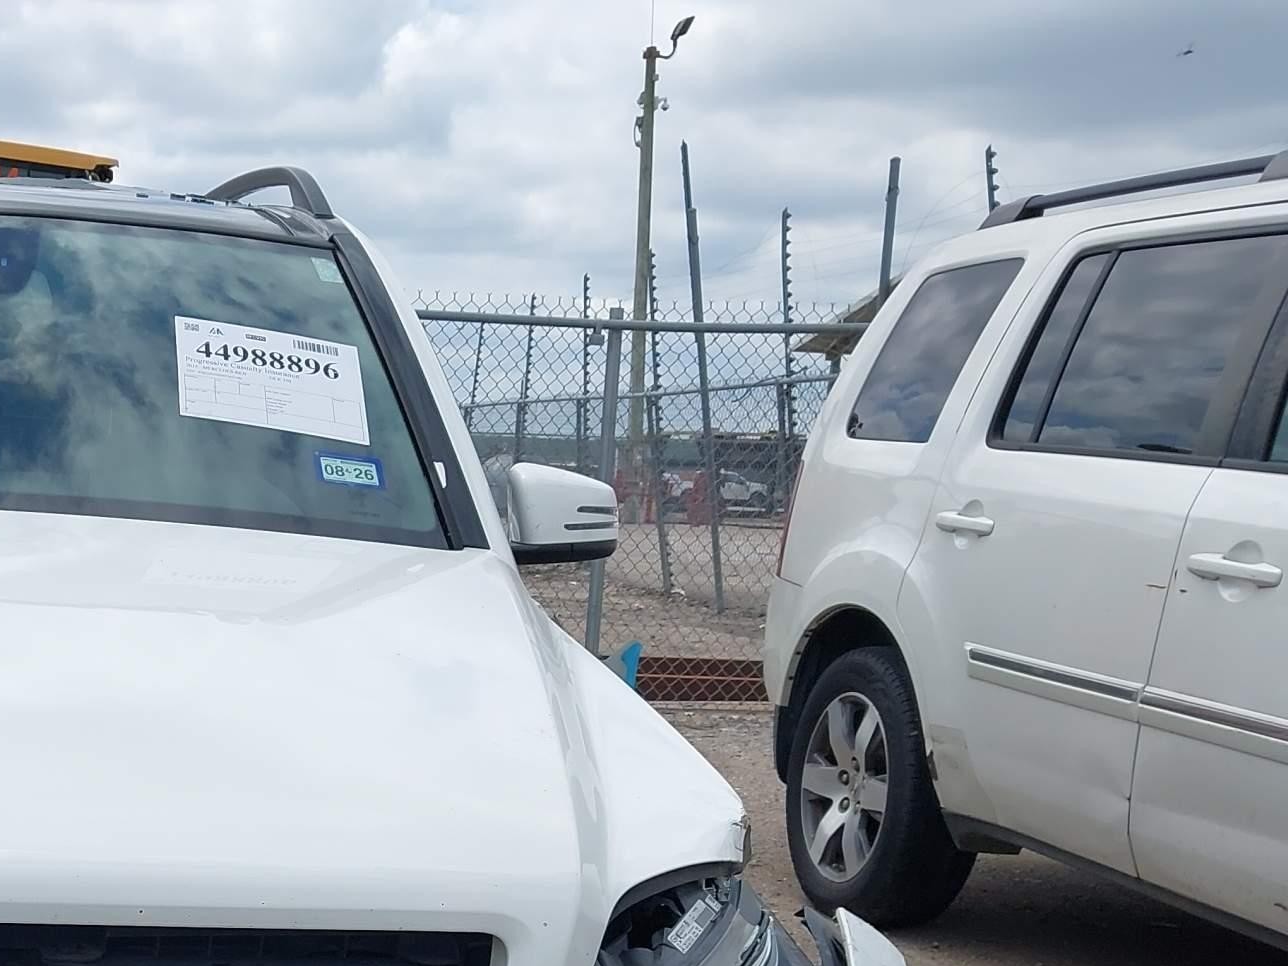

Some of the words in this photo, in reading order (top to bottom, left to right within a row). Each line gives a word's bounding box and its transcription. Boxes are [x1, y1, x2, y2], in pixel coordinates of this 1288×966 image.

[185, 355, 228, 369] Progressive
[196, 341, 340, 380] 44988896
[324, 464, 345, 477] 08
[353, 467, 375, 481] 26
